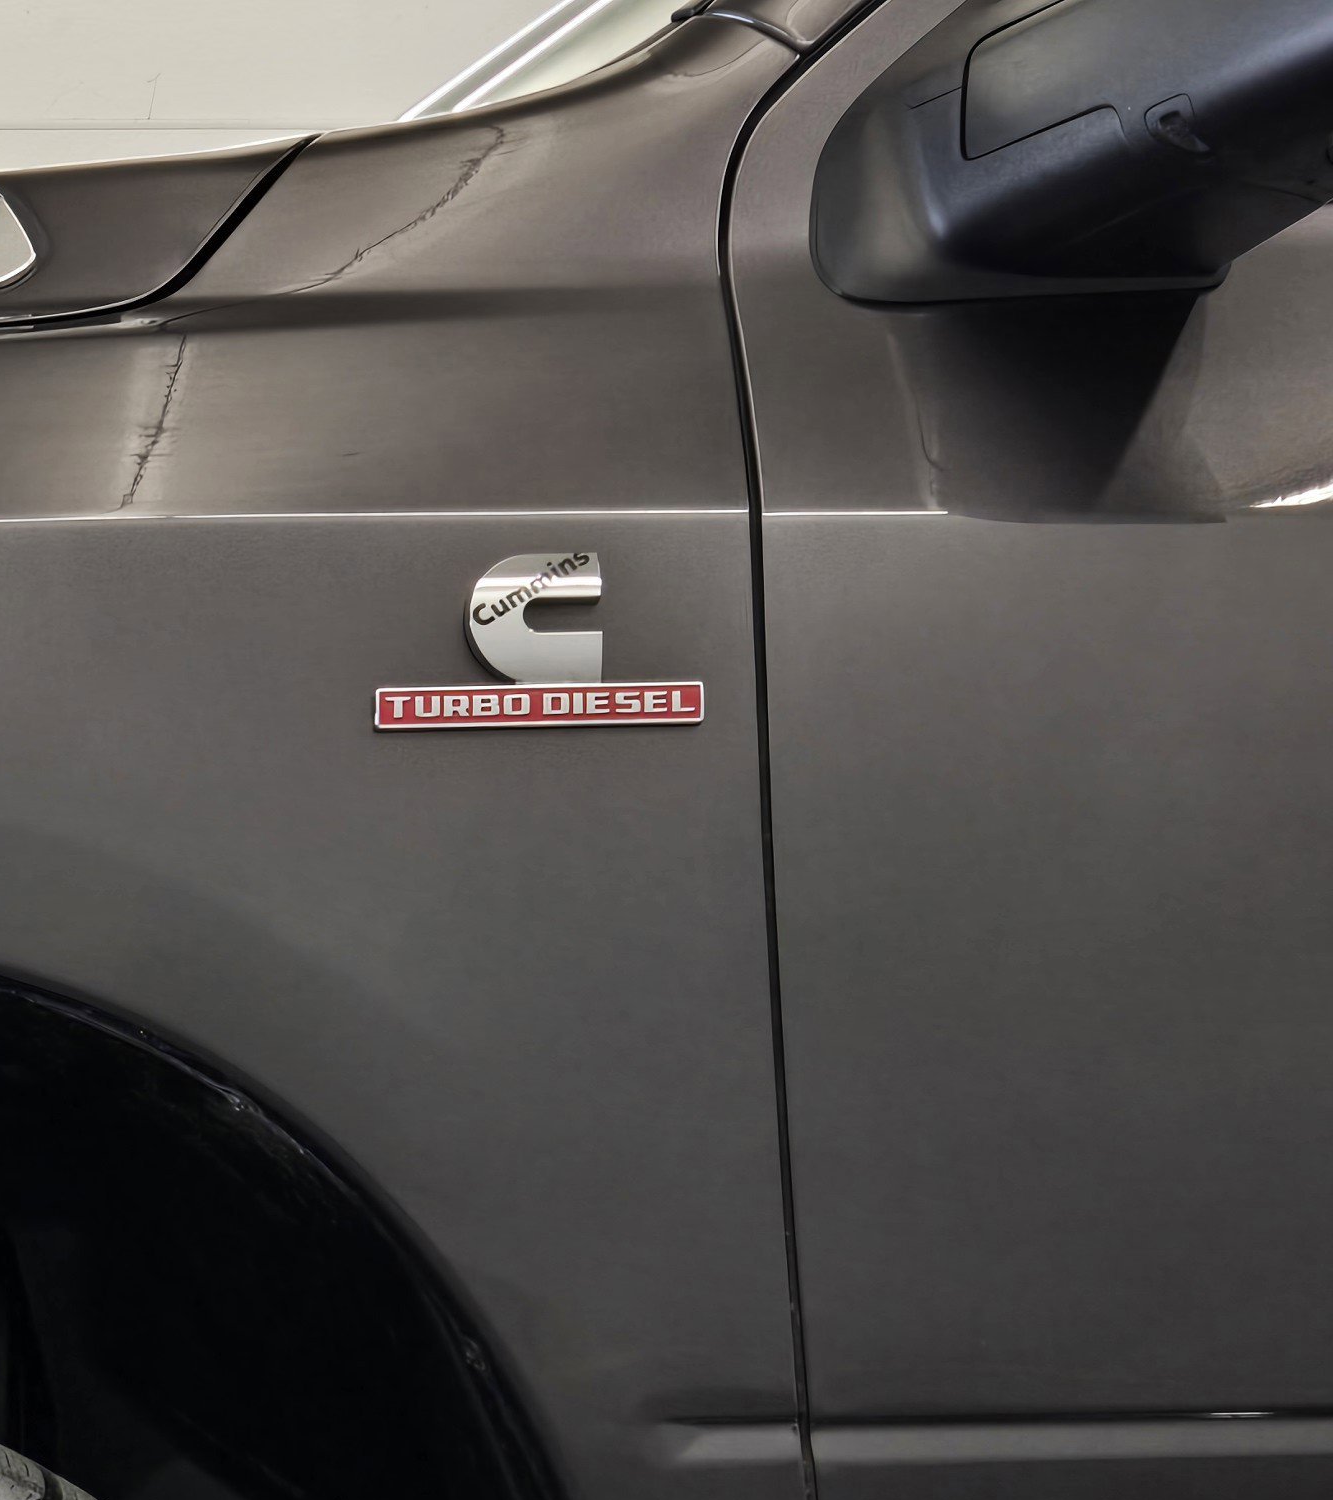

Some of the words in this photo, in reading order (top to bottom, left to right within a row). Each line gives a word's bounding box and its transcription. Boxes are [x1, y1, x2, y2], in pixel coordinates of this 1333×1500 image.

[472, 550, 591, 626] Cummins
[384, 694, 531, 719] TURBO
[542, 690, 696, 716] DIESEL
